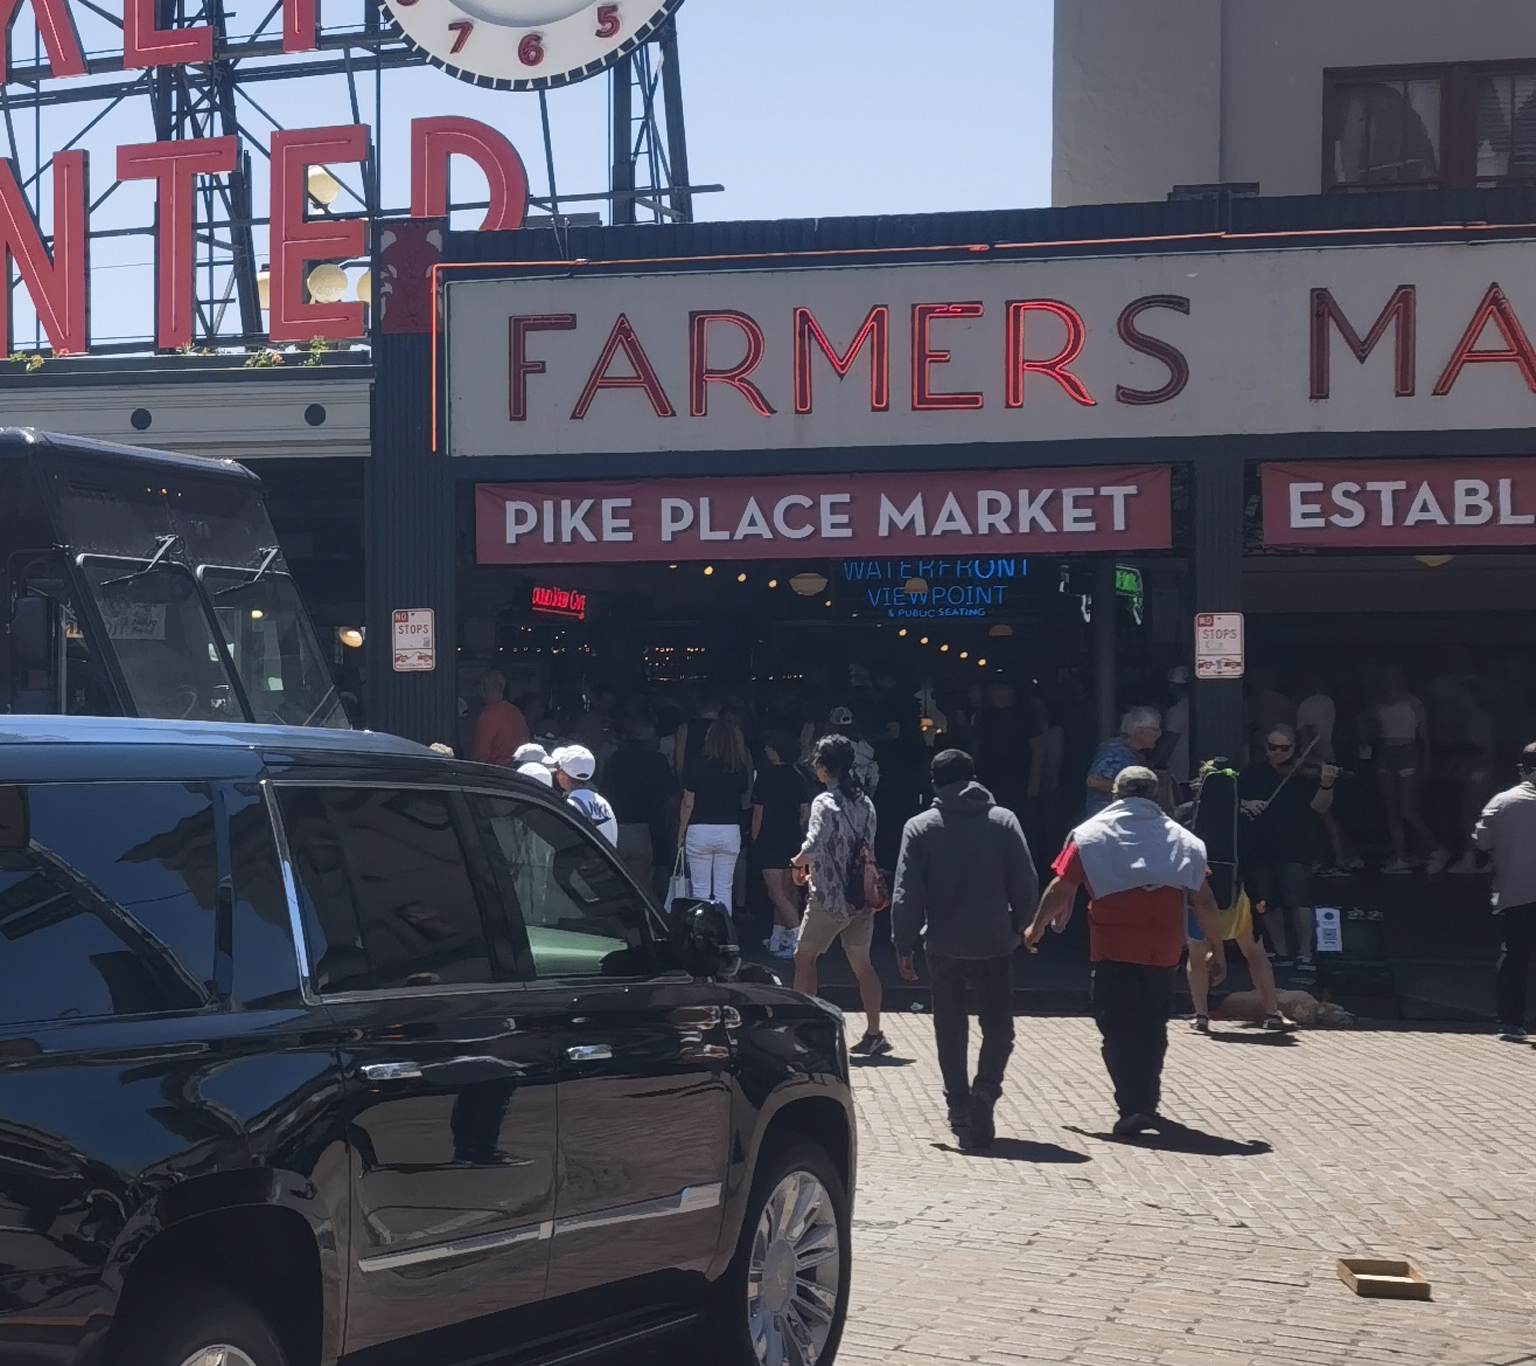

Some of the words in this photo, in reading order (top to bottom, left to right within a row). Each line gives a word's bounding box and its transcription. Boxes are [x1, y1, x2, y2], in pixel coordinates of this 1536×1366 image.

[448, 21, 474, 54] 7
[595, 5, 620, 38] 5
[517, 33, 544, 67] 6
[508, 294, 1190, 421] FARMERS
[1309, 281, 1536, 399] MA
[505, 497, 635, 544] PIKE
[661, 492, 854, 542] PLACE
[878, 485, 1139, 537] MARKET
[1289, 477, 1535, 528] ESTABL
[867, 586, 1008, 607] VIEWPOINT
[898, 608, 935, 618] PUBLIC
[938, 607, 985, 617] SEATING
[396, 613, 406, 621] NO
[398, 624, 429, 634] STOPS
[1202, 629, 1237, 639] STOPS
